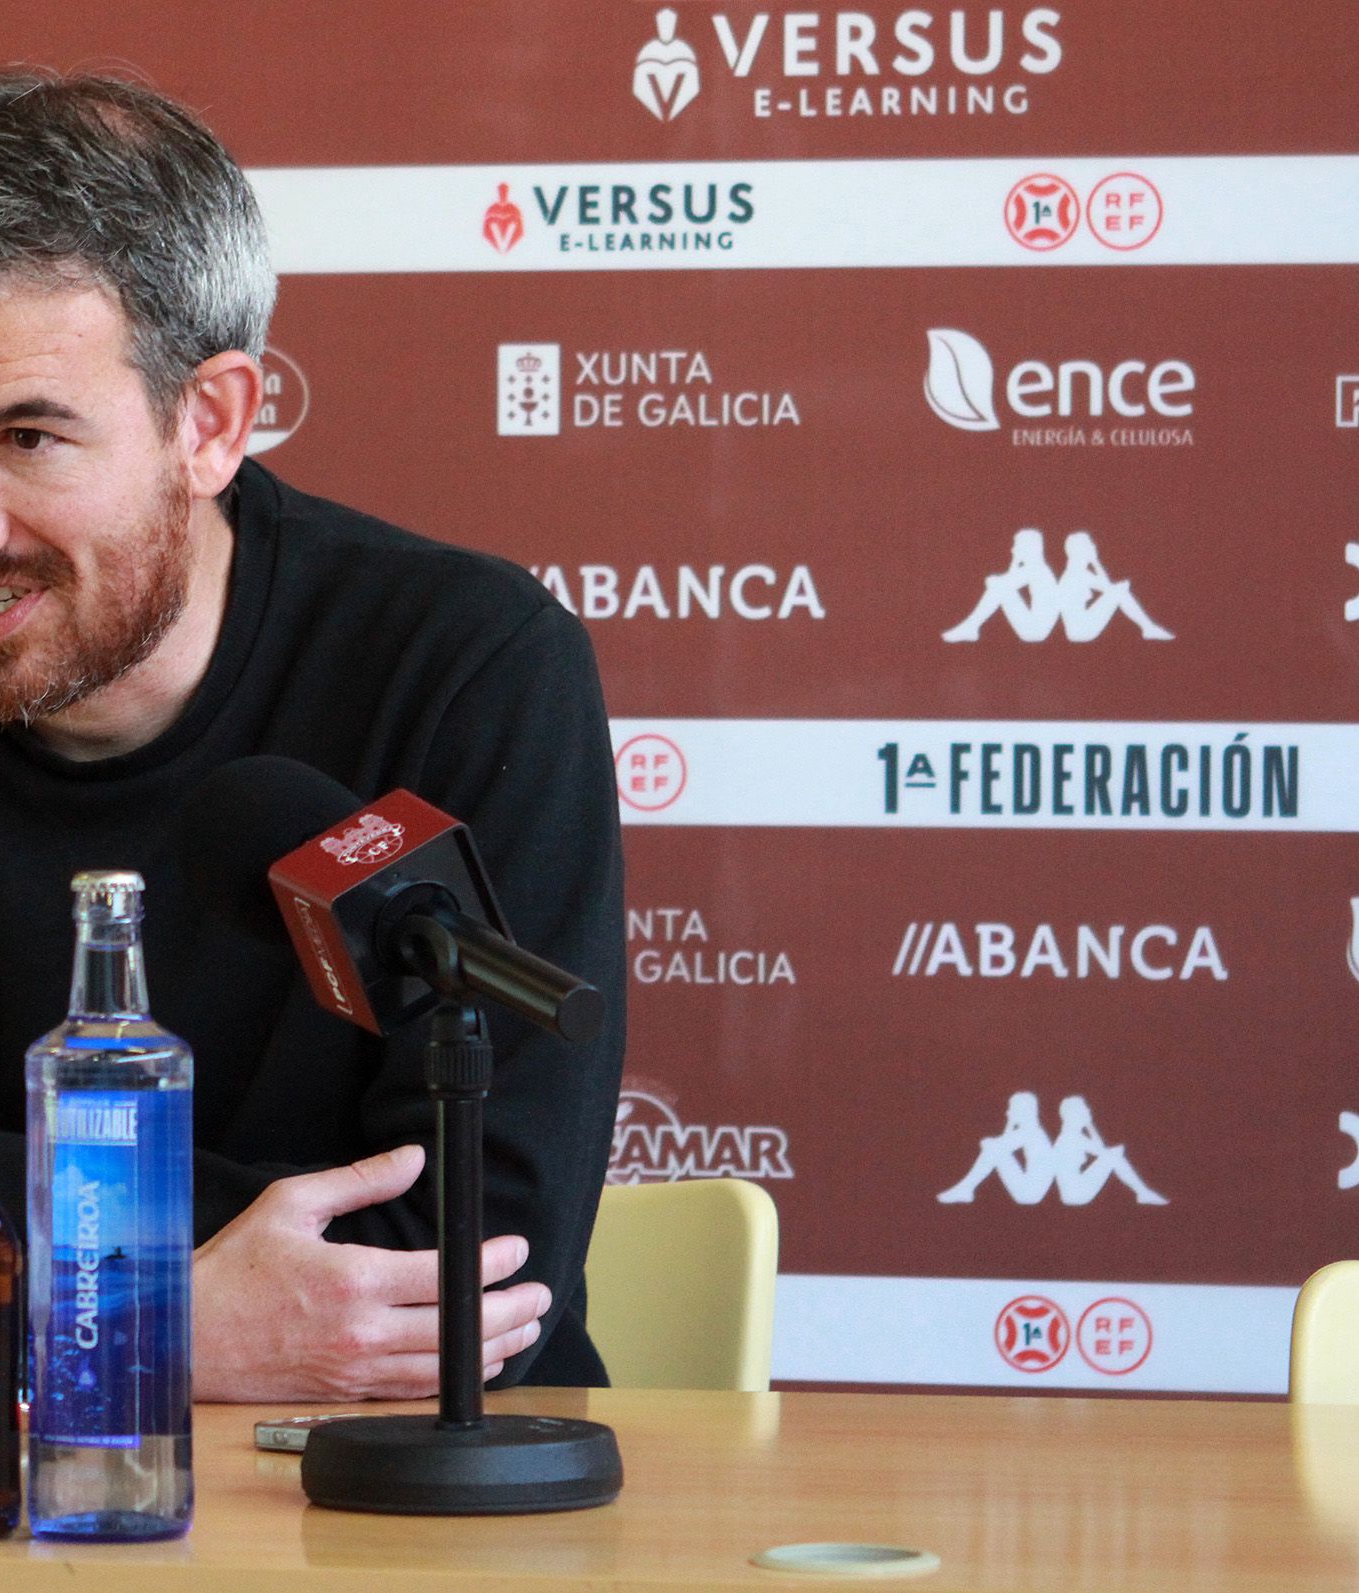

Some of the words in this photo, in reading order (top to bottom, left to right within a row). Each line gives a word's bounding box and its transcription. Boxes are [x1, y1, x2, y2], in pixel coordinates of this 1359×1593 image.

[712, 8, 1061, 77] VERSUS
[754, 85, 1028, 117] E-LEARNING
[534, 183, 754, 225] VERSUS
[560, 232, 732, 251] E-LEARNING
[577, 351, 712, 385] XUNTA
[1007, 361, 1195, 417] ence
[574, 394, 623, 427] DE
[637, 392, 800, 427] GALICIA
[1091, 429, 1104, 446] &
[1110, 429, 1193, 446] CELULOSA
[950, 733, 1298, 818] FEDERACIÓN
[634, 950, 795, 985] GALICIA
[74, 1180, 100, 1350] CABREIROA
